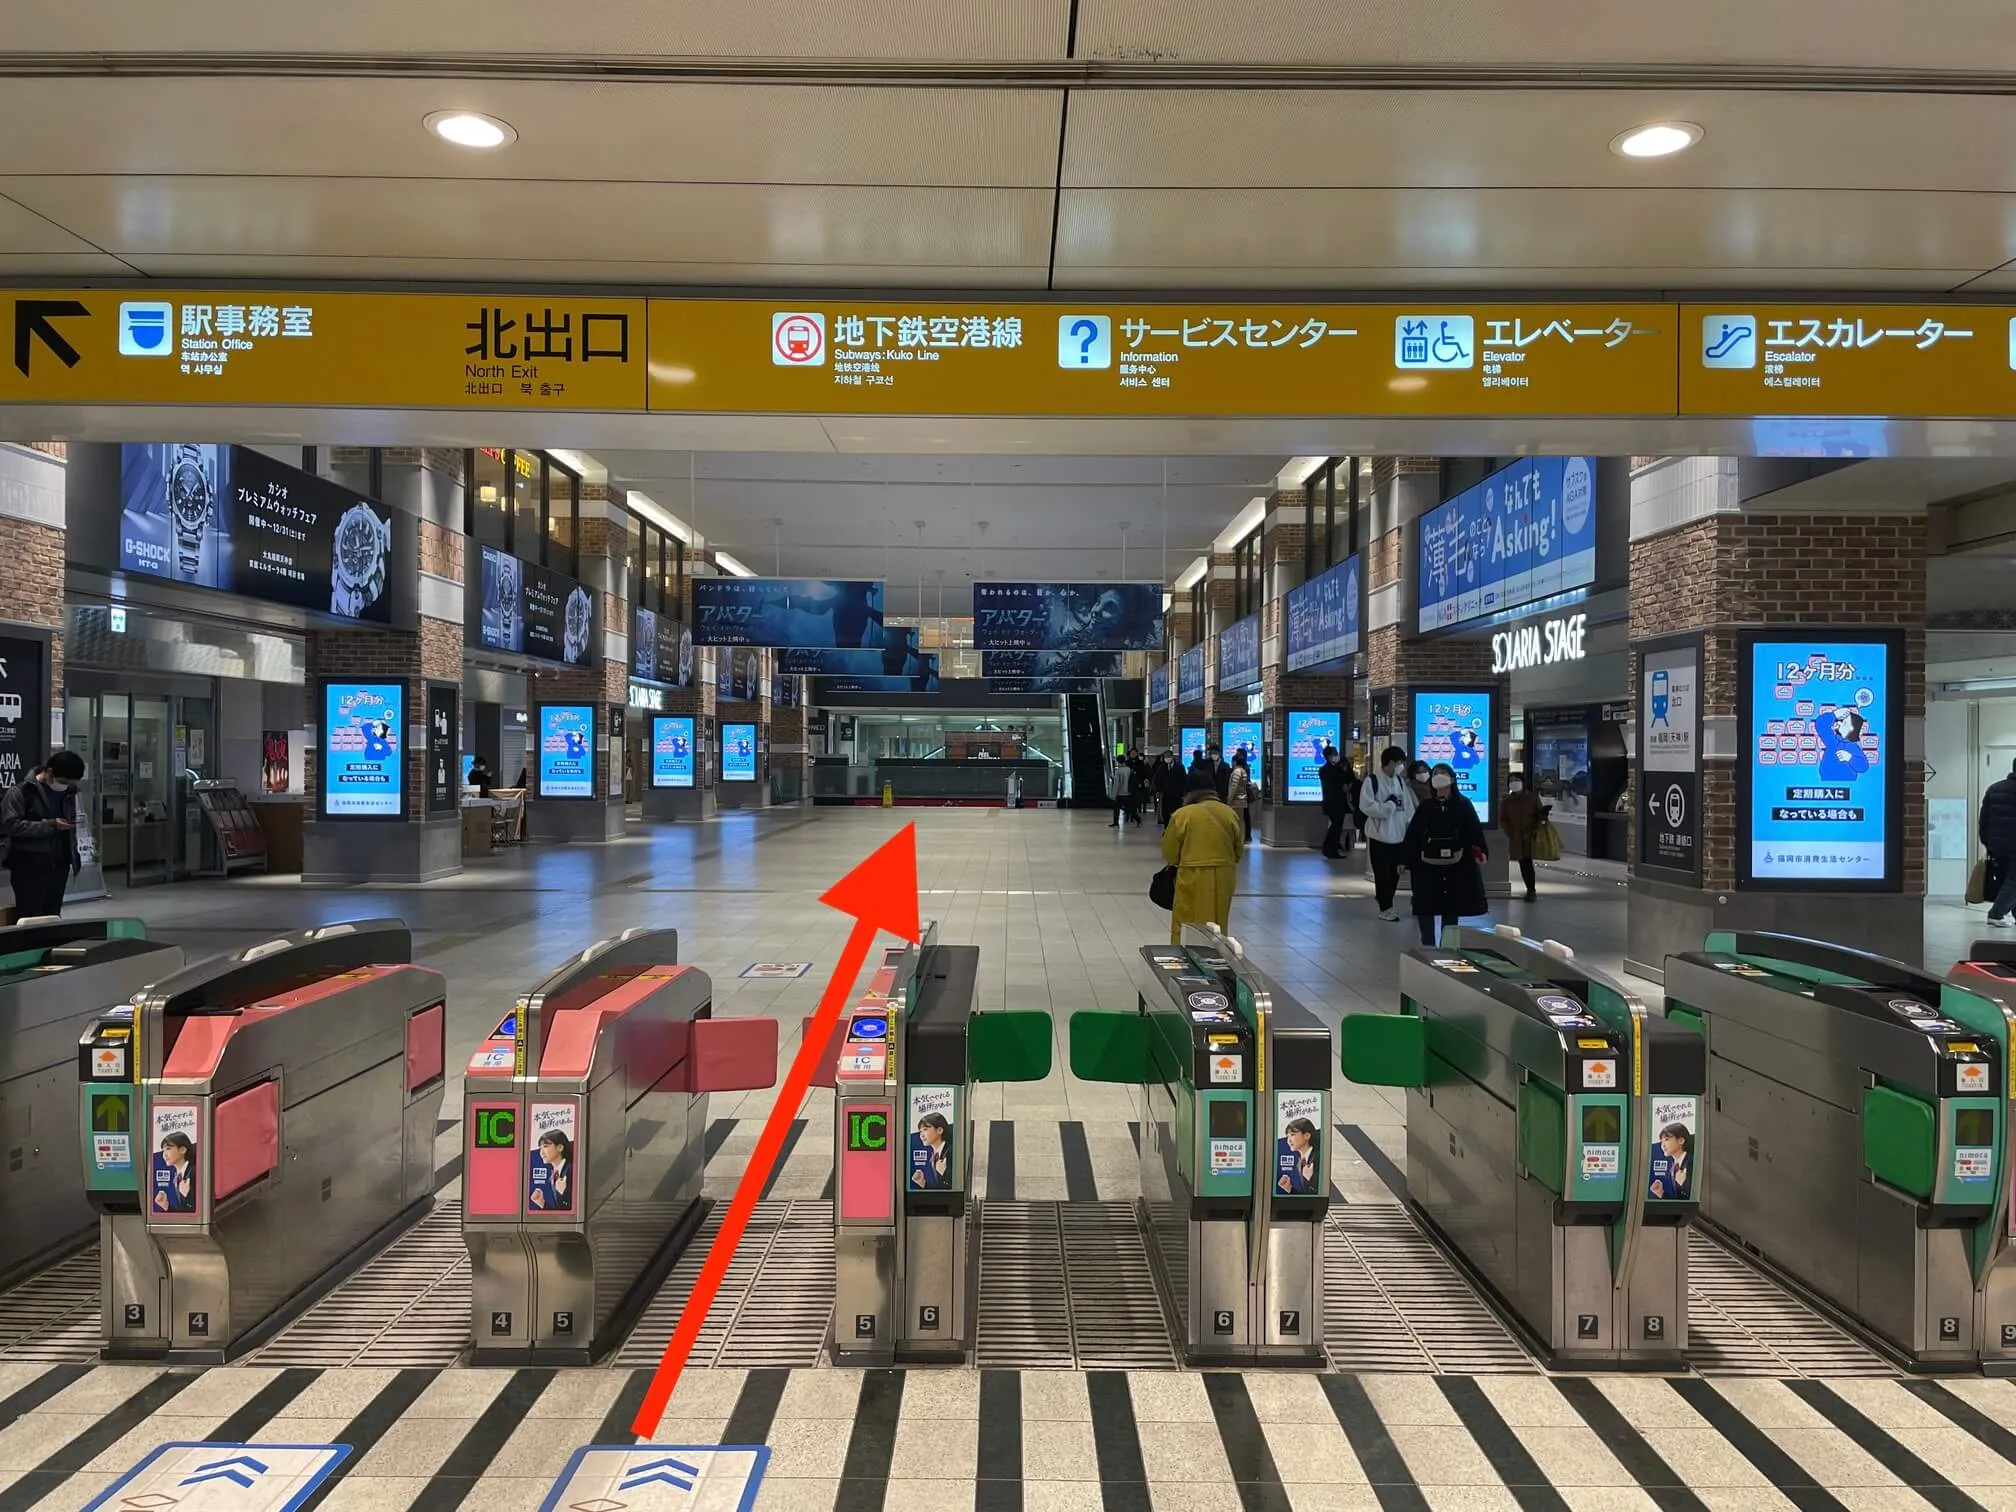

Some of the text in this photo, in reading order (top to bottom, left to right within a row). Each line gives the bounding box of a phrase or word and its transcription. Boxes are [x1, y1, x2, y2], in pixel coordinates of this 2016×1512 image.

[181, 304, 313, 336] 駅事務室
[465, 308, 628, 362] 北出口
[834, 315, 1022, 347] 地下鉄空港線
[1120, 317, 1358, 348] サービスセンター
[1483, 317, 1662, 348] エレベーター
[1765, 318, 1974, 349] エスカレーター
[181, 339, 253, 349] Station Office
[917, 350, 940, 360] Line
[1120, 352, 1178, 362] Information
[1483, 351, 1526, 362] Elevator
[1765, 351, 1816, 362] Escalator
[465, 365, 539, 378] North Exit
[465, 382, 502, 394] 北出口
[268, 482, 288, 499] カシオ
[1505, 469, 1541, 514] なんでも
[238, 488, 317, 525] プレミアムウォッチフェア
[1491, 499, 1556, 564] Asking!
[125, 538, 171, 563] G-SHOCK
[1424, 508, 1469, 588] 薄毛
[699, 605, 766, 622] アバター
[980, 609, 1046, 626] アバター
[1492, 613, 1586, 674] SOLARIA STAGE
[1792, 788, 1844, 800] 定期購入に
[1779, 808, 1857, 820] なっている場合も
[478, 1112, 514, 1145] IC
[851, 1114, 886, 1148] IC
[128, 1304, 141, 1320] 3
[495, 1313, 509, 1327] 4
[557, 1312, 569, 1327] 5
[924, 1306, 936, 1323] 6
[1218, 1312, 1231, 1328] 6
[1283, 1312, 1296, 1328] 7
[191, 1313, 205, 1328] 4
[860, 1315, 872, 1331] 5
[1582, 1316, 1594, 1331] 7
[1647, 1317, 1660, 1331] 8
[1943, 1318, 1956, 1333] 8
[2005, 1326, 2016, 1340] 9
